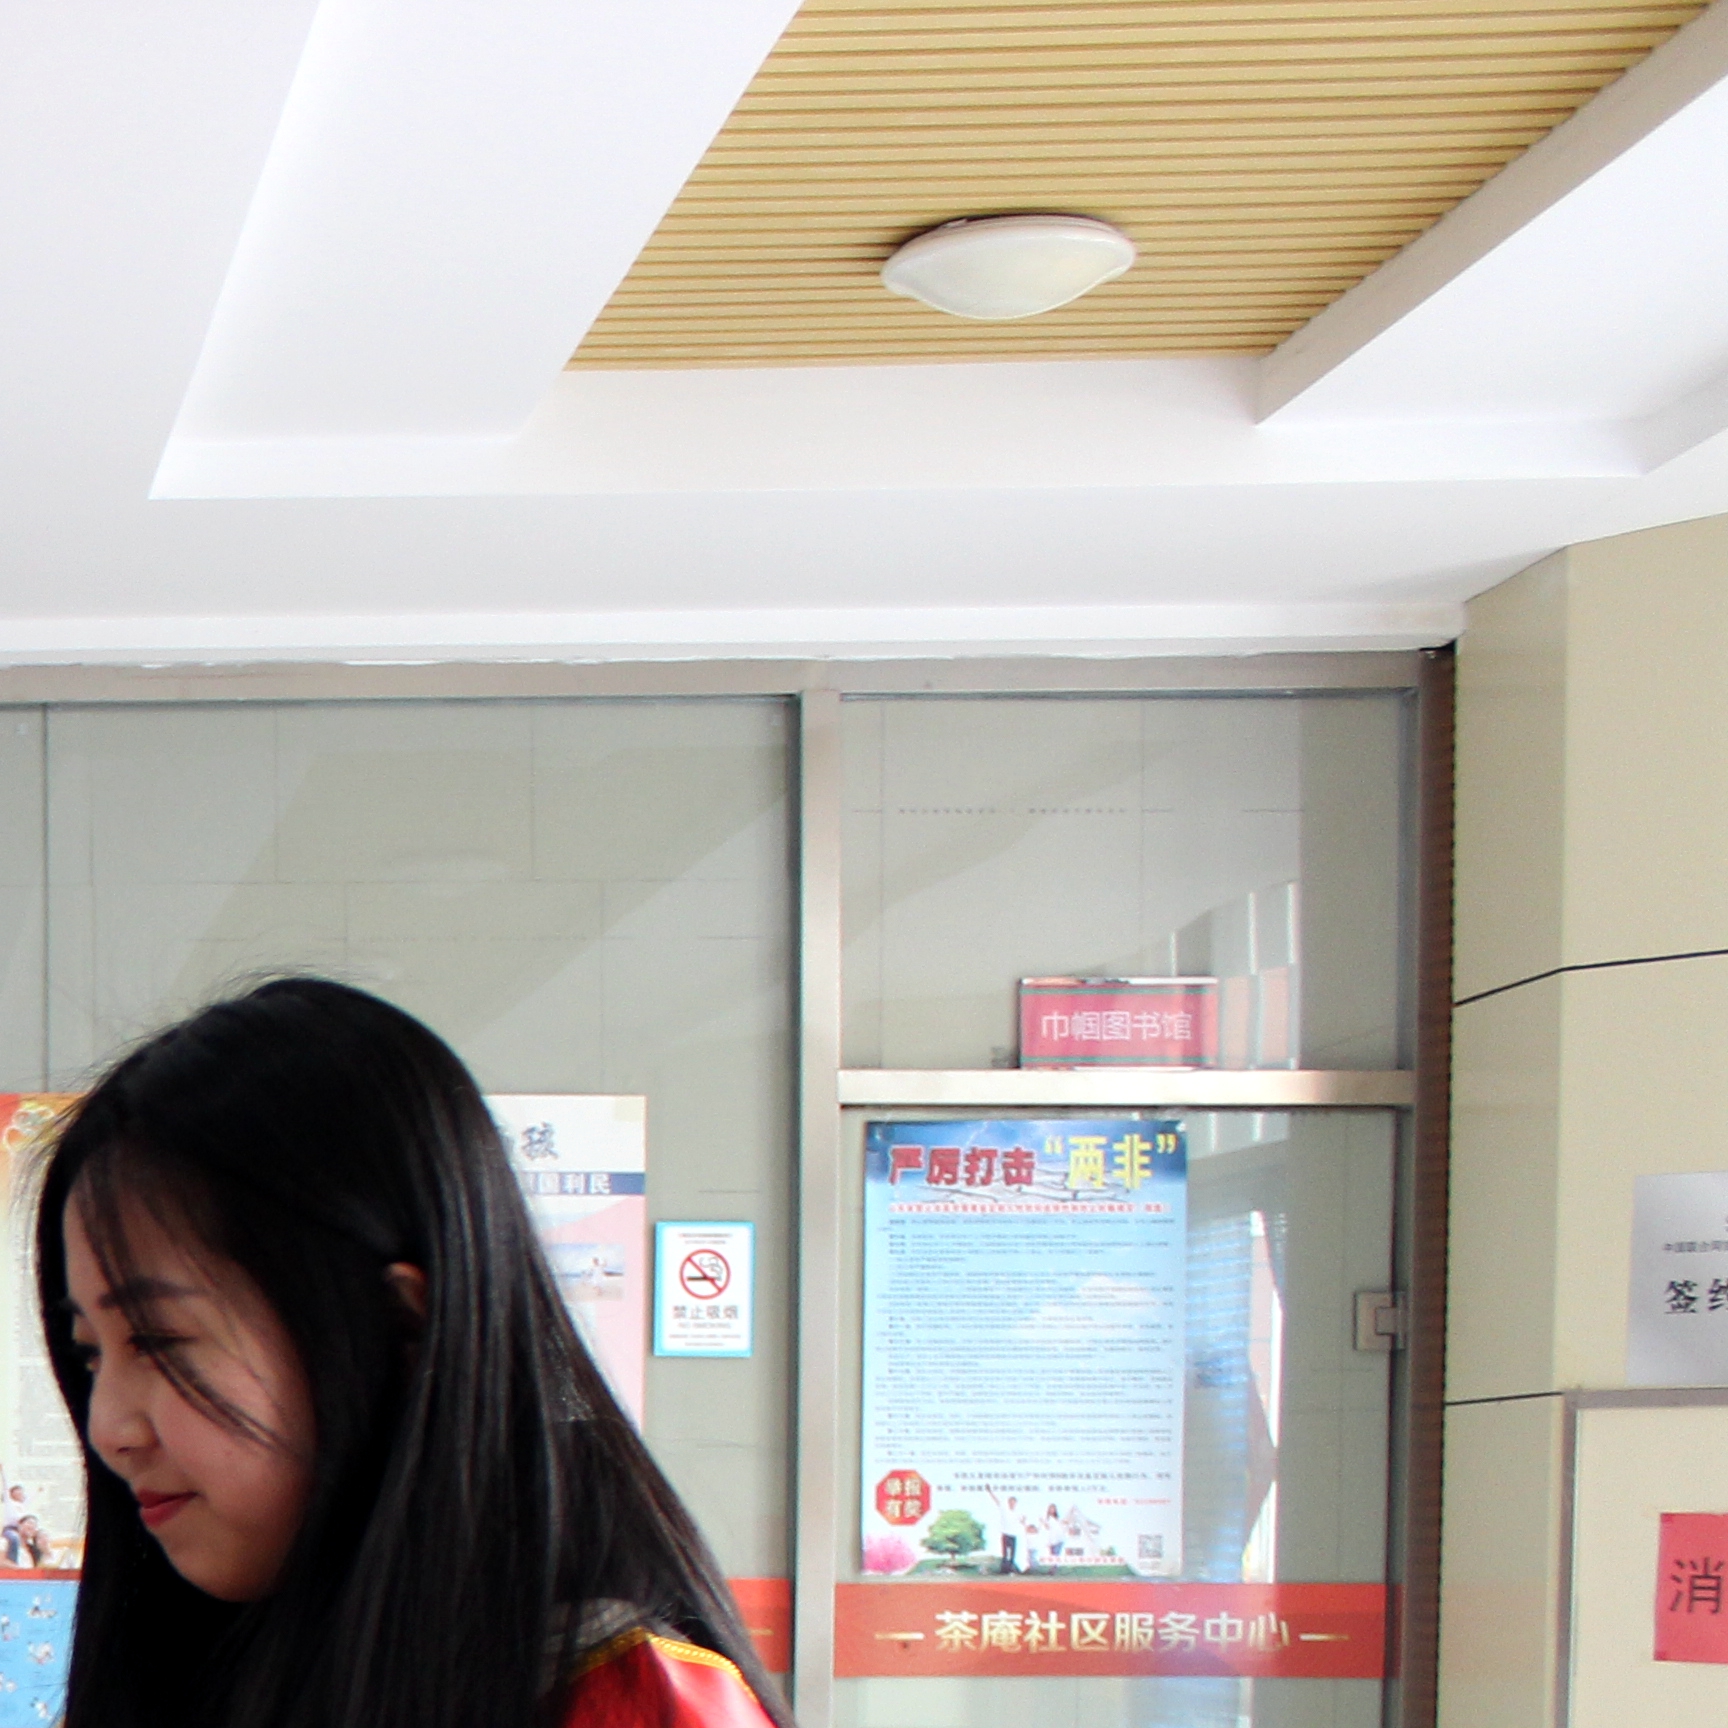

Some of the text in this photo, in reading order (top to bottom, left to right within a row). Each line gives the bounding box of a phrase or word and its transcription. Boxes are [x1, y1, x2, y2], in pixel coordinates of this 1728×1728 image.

[1041, 1010, 1193, 1042] 巾帼图书馆
[1668, 1556, 1727, 1615] 消
[935, 1610, 1290, 1653] 茶庵社区服务中心
